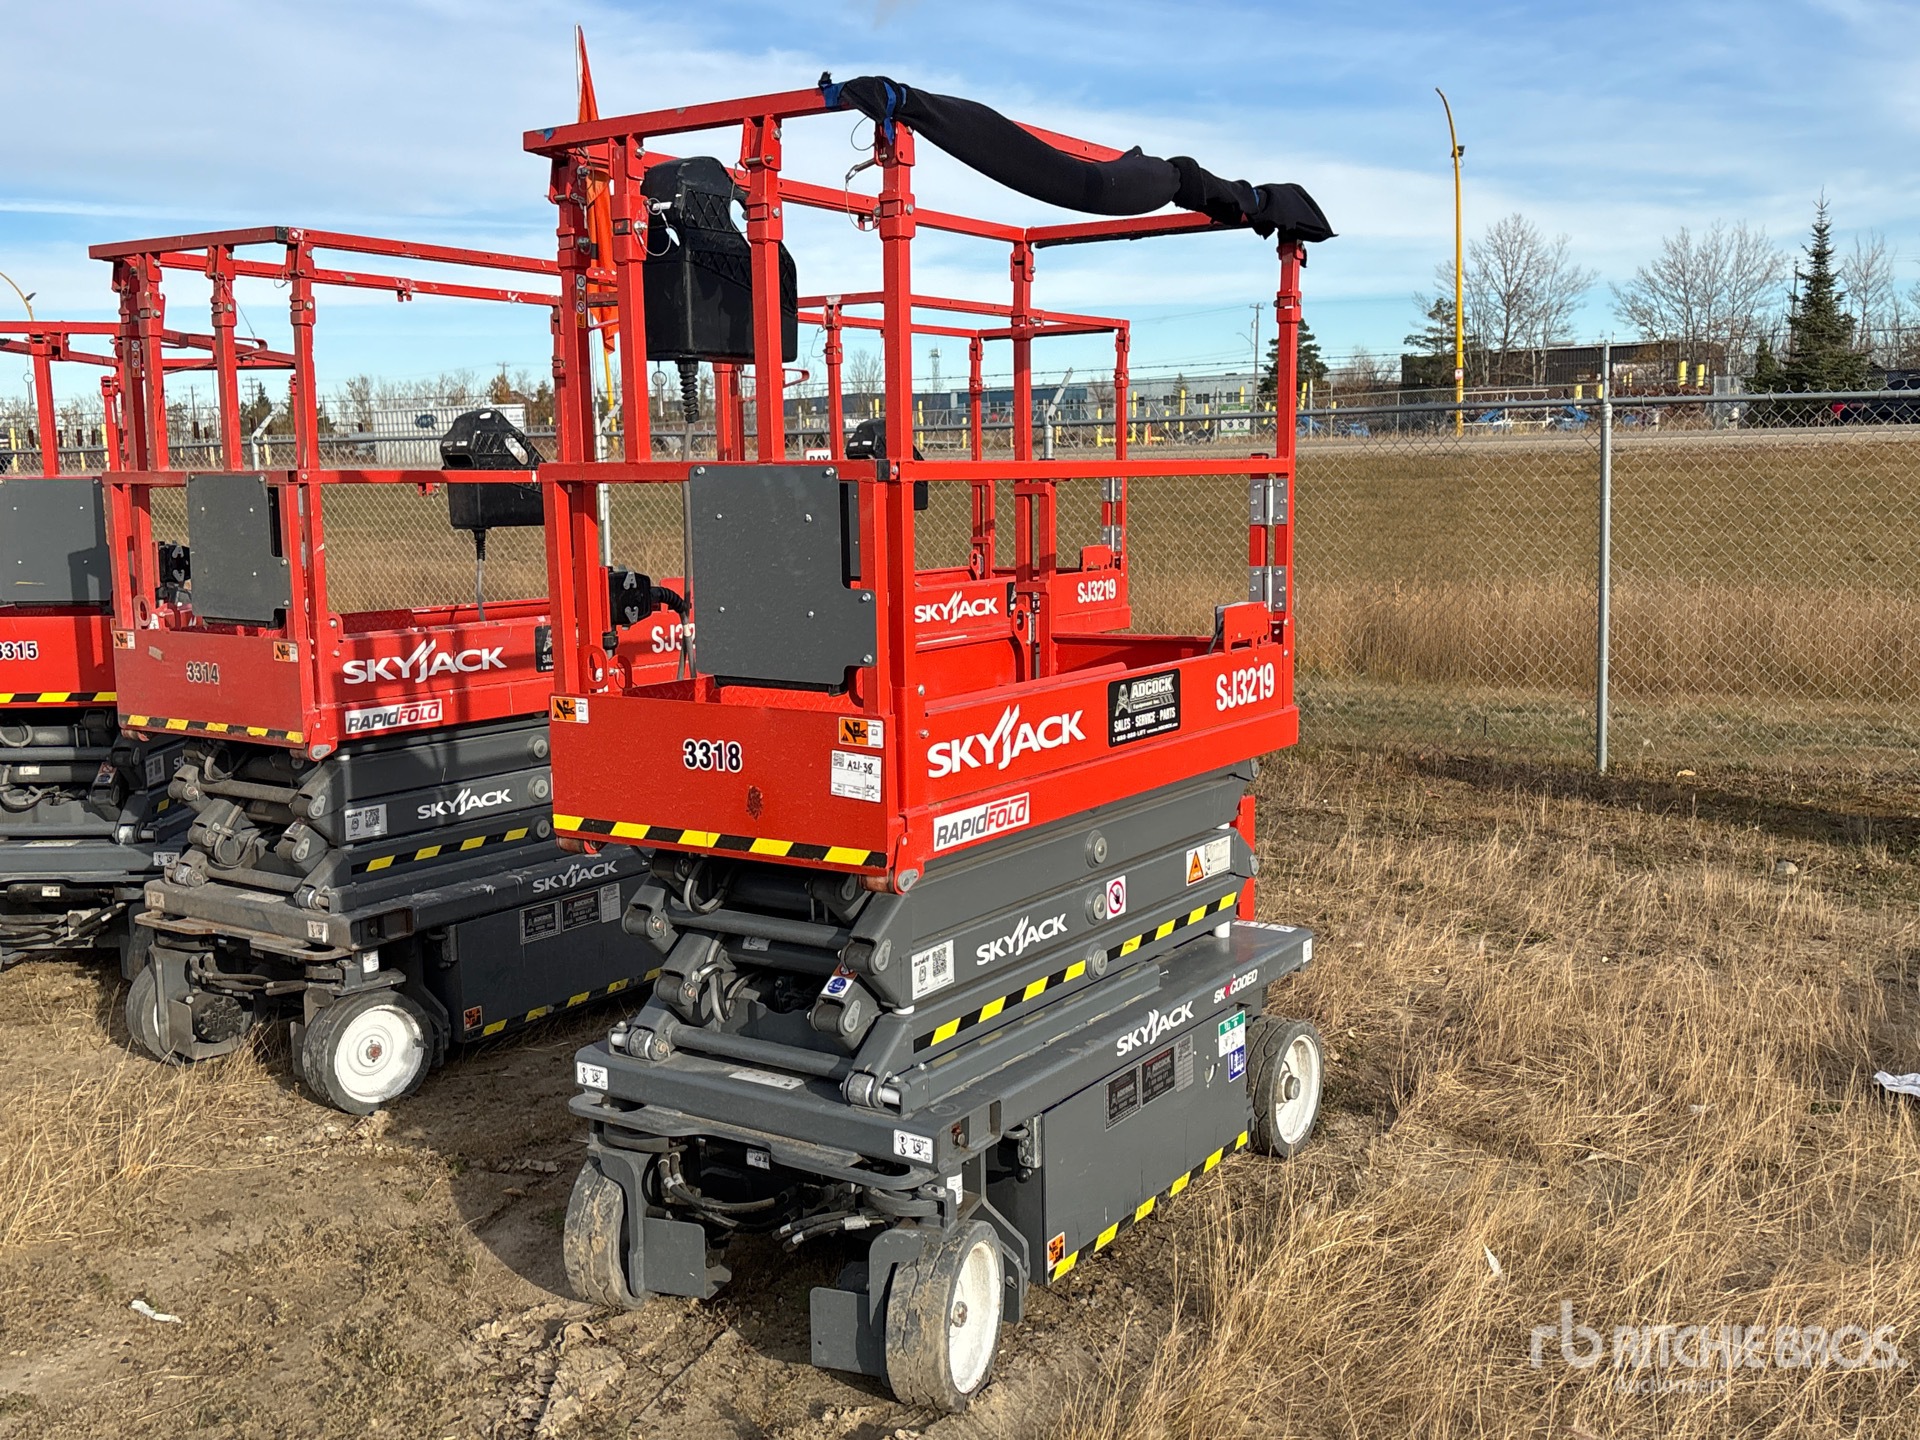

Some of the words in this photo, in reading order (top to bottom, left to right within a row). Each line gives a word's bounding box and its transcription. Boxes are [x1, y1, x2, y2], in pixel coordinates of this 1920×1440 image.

[914, 591, 999, 624] SKYJACK
[1077, 578, 1116, 604] SJ3219
[186, 661, 220, 685] 3314
[342, 638, 508, 684] SKYJACK
[1131, 677, 1173, 700] ADCOCK
[1215, 662, 1275, 712] SJ3219
[1114, 717, 1131, 733] SALES
[1135, 711, 1156, 727] SERVICE
[1159, 707, 1176, 721] PARTS
[683, 738, 743, 773] 3318
[926, 703, 1087, 779] SKYJACK
[417, 788, 513, 820] SKYJACK
[532, 860, 618, 893] SKYJACK
[976, 913, 1068, 966] SKYJACK
[1116, 1001, 1195, 1057] SKYJACK
